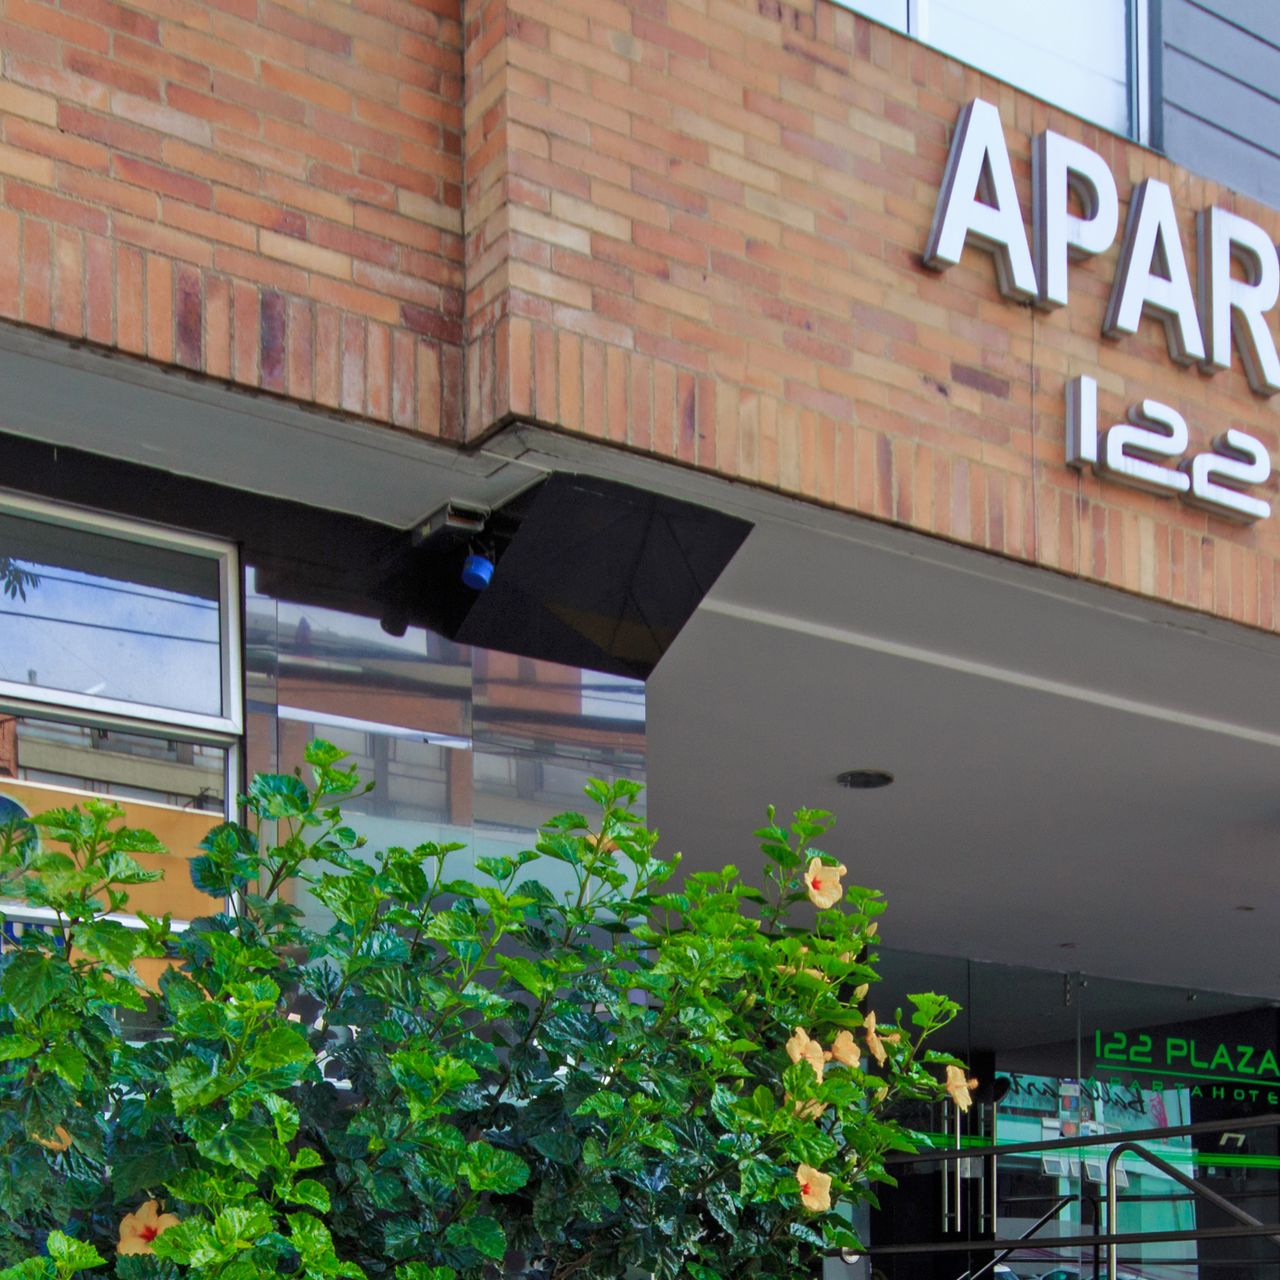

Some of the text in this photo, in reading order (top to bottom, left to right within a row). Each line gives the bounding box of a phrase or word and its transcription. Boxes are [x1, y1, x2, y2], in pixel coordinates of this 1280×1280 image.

[1065, 374, 1271, 525] 122
[1095, 1029, 1280, 1077] 122 PLAZA
